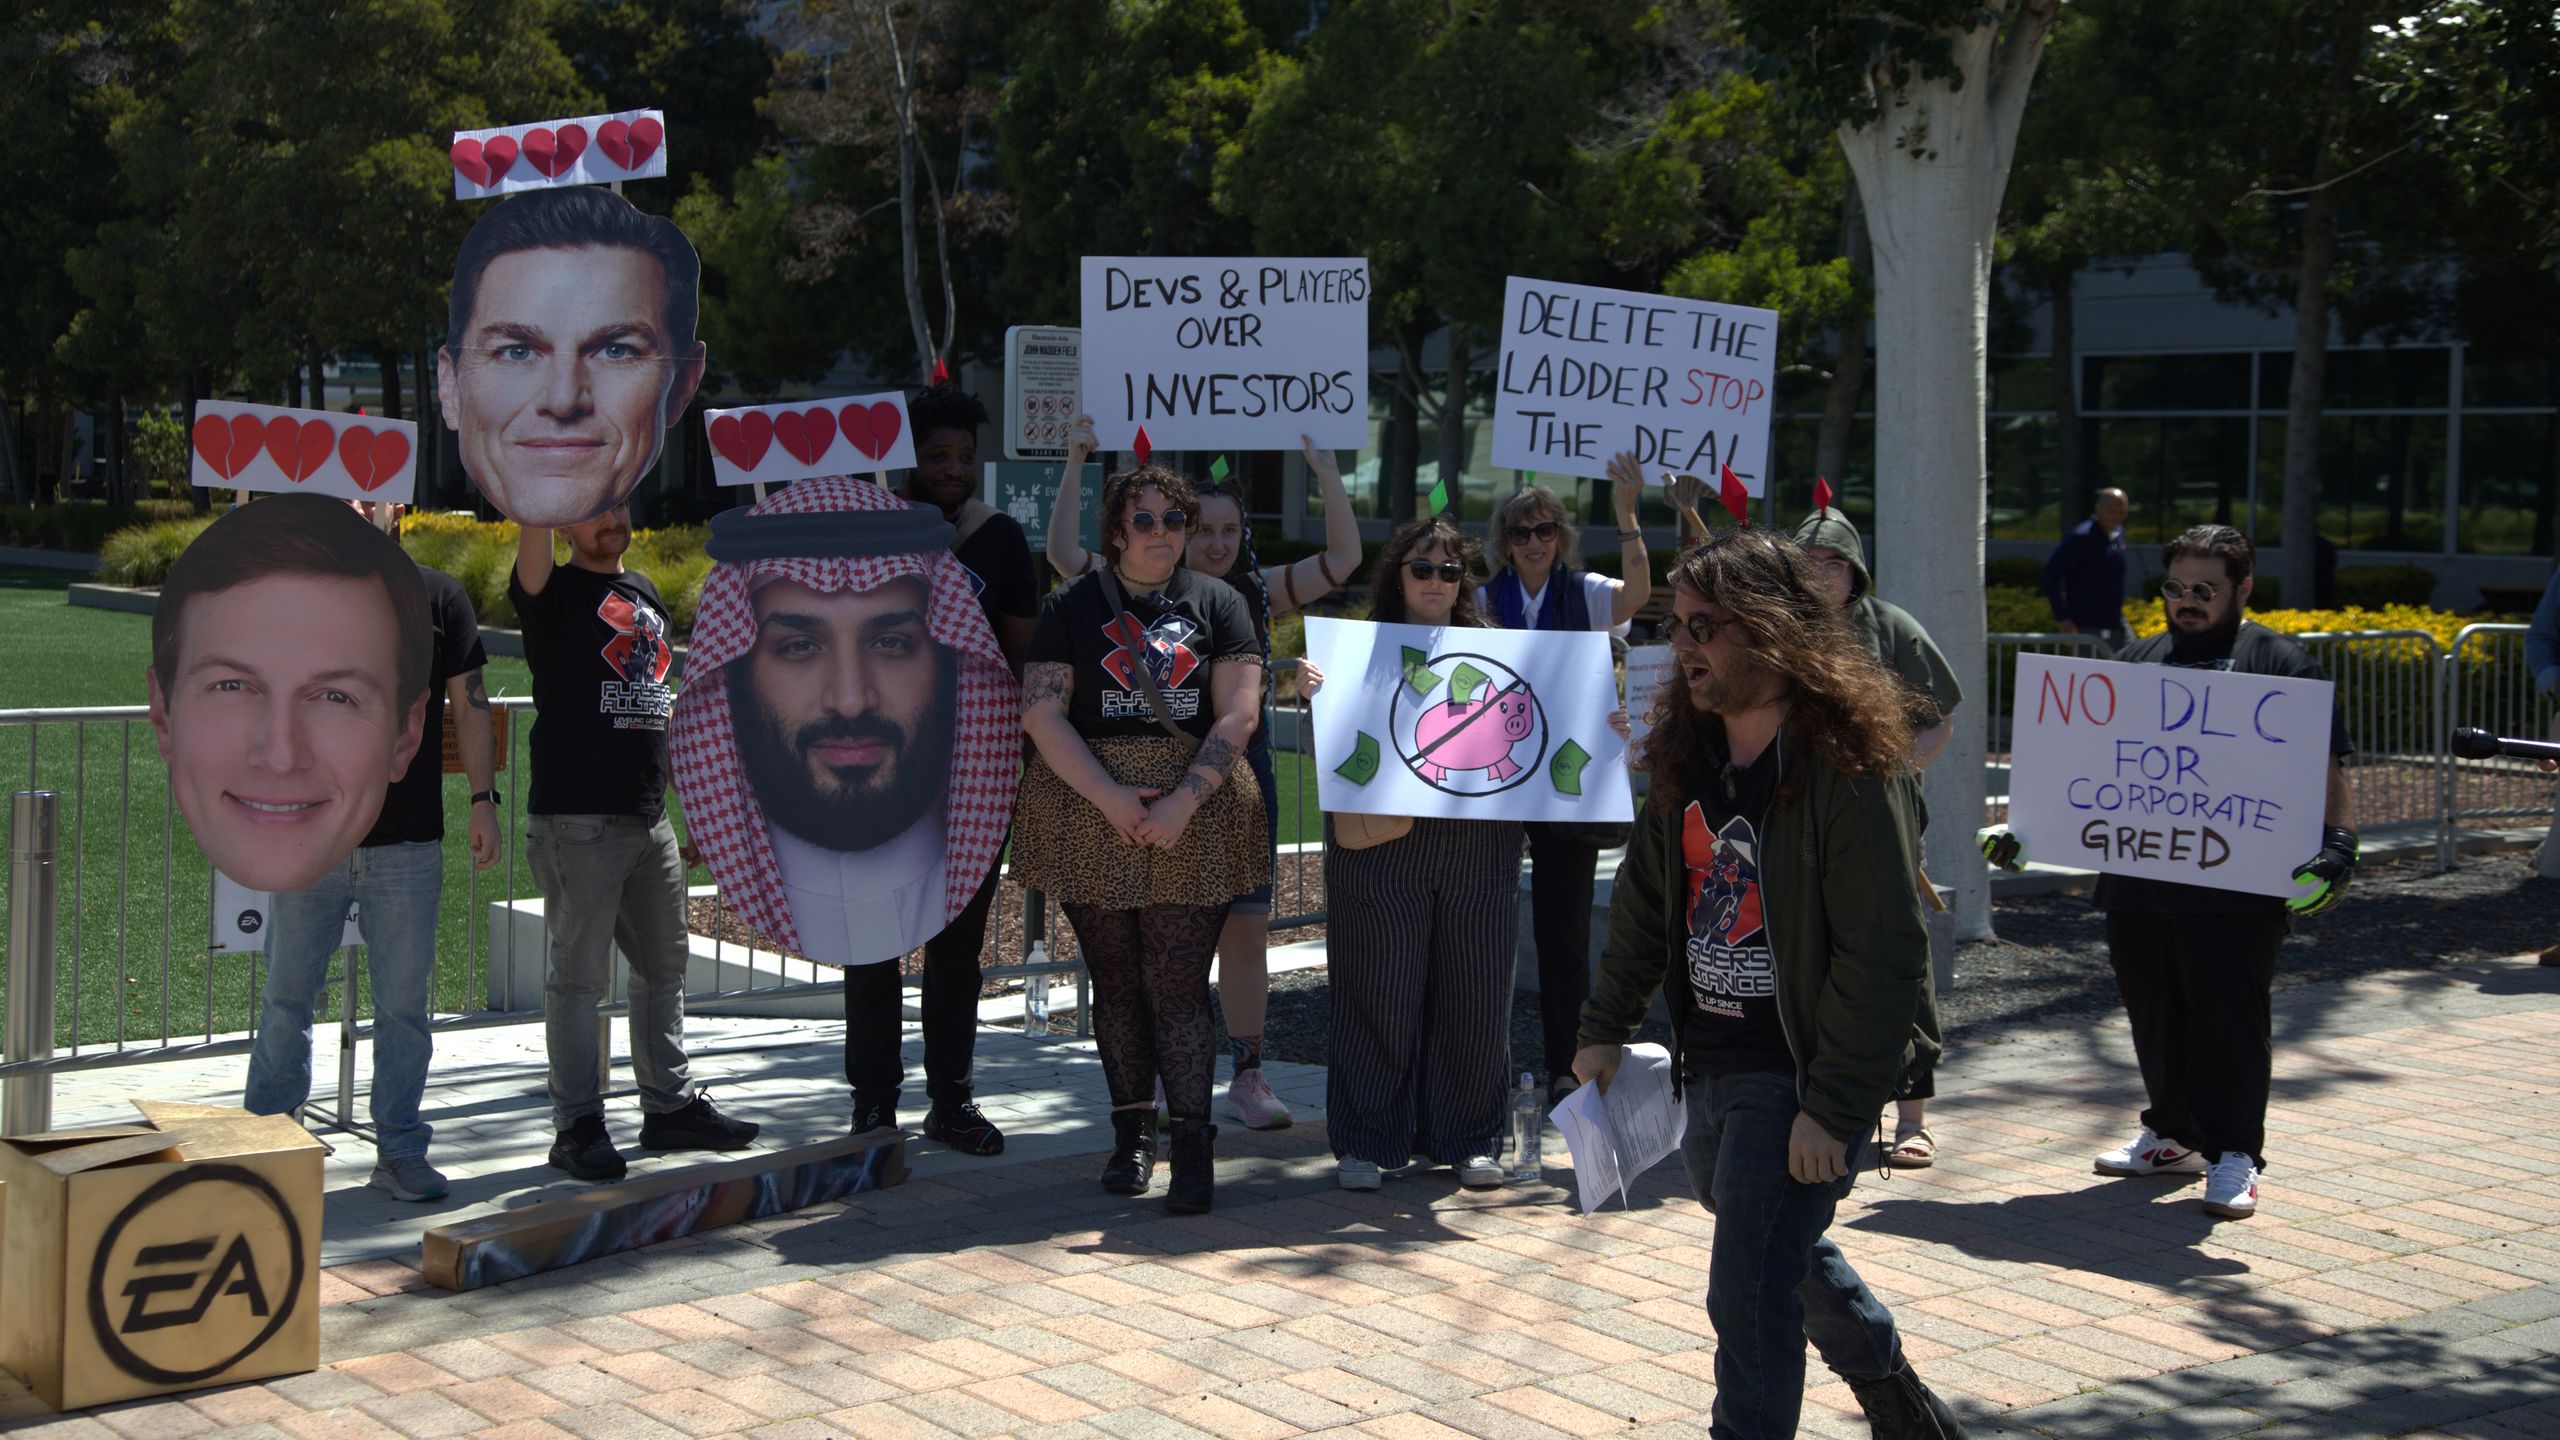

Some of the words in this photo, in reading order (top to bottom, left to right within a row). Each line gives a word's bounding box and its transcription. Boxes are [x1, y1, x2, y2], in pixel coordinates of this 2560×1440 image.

[1106, 267, 1202, 311] DEVS
[1219, 269, 1249, 309] &
[1259, 267, 1368, 306] PLAYERS
[1176, 313, 1262, 348] OVER
[1519, 290, 1677, 346] DELETE
[1687, 311, 1766, 360] THE
[1024, 344, 1038, 355] JOHN
[1039, 345, 1061, 356] MADDEN
[1062, 346, 1077, 357] FIELD
[1125, 371, 1353, 421] INVESTORS
[1502, 349, 1668, 407] LADDER
[1680, 368, 1764, 415] STOP
[1516, 410, 1603, 459] THE
[1634, 425, 1755, 480] DEAL
[601, 681, 671, 702] PLAYERS
[1102, 689, 1200, 705] PLAERS
[2037, 670, 2116, 726] NO
[2160, 678, 2287, 743] DLC
[2114, 739, 2208, 788] FOR
[2068, 776, 2282, 833] CORPORATE
[2081, 818, 2231, 870] GREED
[241, 916, 260, 927] EA
[1687, 938, 1775, 974] AYERS
[1706, 996, 1717, 1005] UP
[1717, 1000, 1743, 1010] SINCE
[118, 1232, 269, 1334] EA
